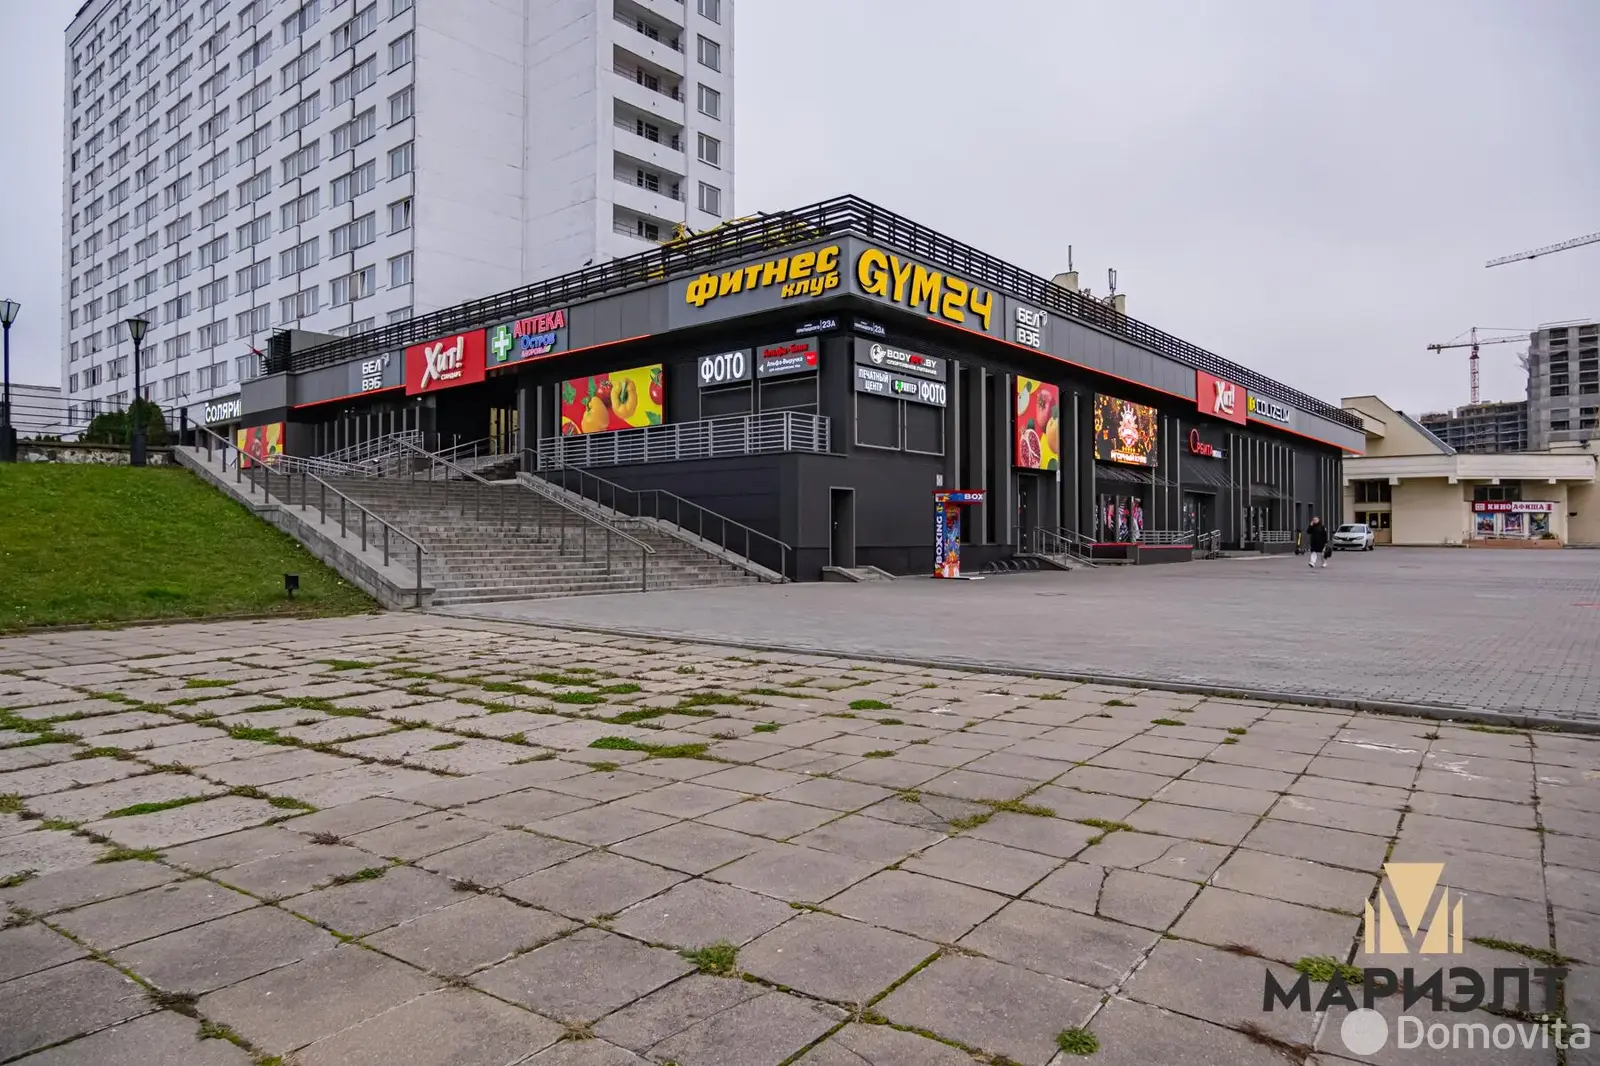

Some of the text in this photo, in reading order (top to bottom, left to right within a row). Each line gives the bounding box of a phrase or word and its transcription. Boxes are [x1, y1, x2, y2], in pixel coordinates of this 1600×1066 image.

[686, 245, 840, 307] фитнес
[780, 271, 839, 299] клуб
[858, 248, 993, 331] GYM24
[513, 310, 565, 339] АПТЕКА
[1016, 307, 1040, 327] БЕЛ
[1016, 327, 1040, 348] ВЭБ
[362, 359, 382, 375] БЕЛ
[701, 352, 744, 383] ФОТО
[886, 348, 938, 369] BODY.BY
[362, 376, 382, 392] ВЭБ
[858, 368, 889, 384] ПЕЧАТНЫЙ
[865, 380, 884, 392] ЦЕНТР
[921, 381, 946, 405] ФОТО
[1512, 503, 1545, 511] АФИША
